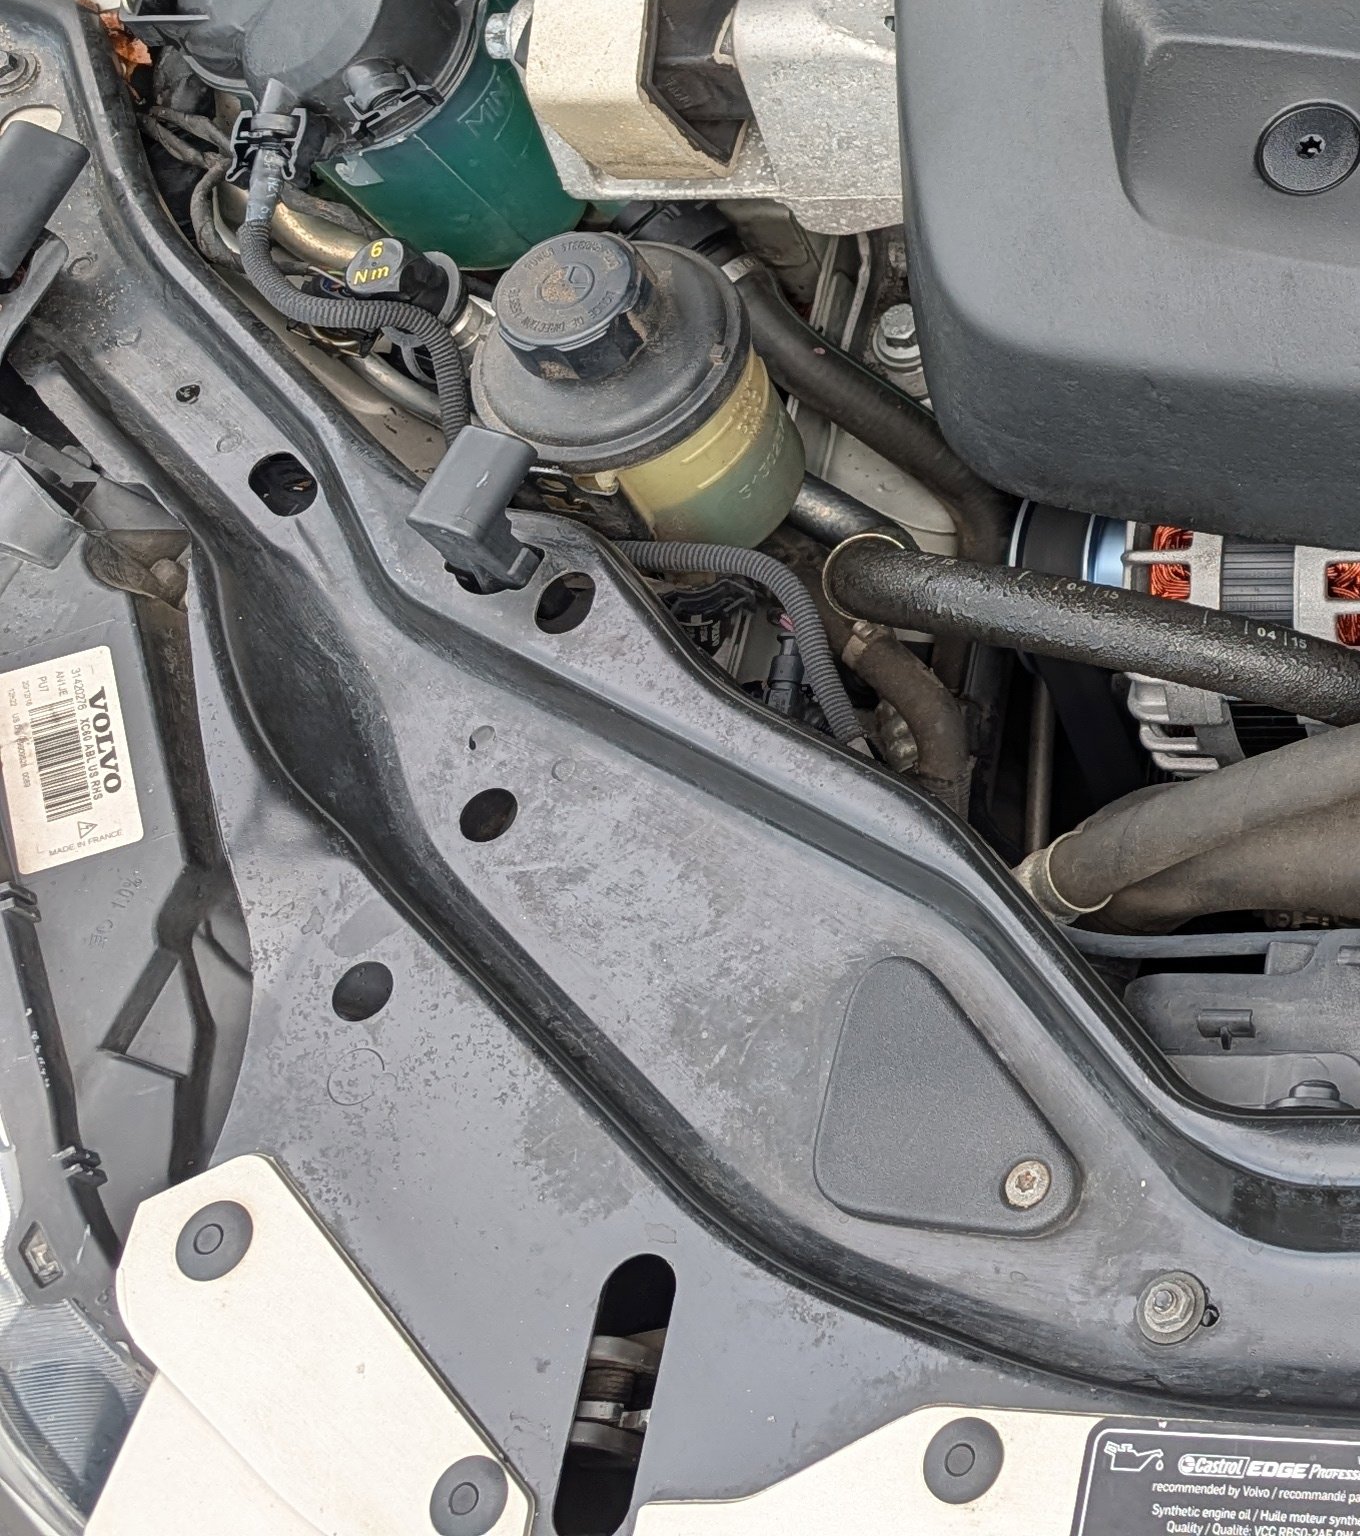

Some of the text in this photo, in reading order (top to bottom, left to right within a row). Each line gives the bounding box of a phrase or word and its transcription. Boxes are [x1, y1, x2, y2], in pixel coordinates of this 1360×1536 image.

[370, 240, 384, 258] 6
[1256, 627, 1277, 640] 04
[1290, 636, 1308, 650] 15
[71, 667, 104, 801] 31420276 XC60 ABL US RHS
[88, 686, 122, 794] VOLVO
[48, 828, 124, 856] MADE IN FRANCE
[1194, 1457, 1244, 1475] Castrol
[1246, 1460, 1310, 1479] EDGE
[1152, 1482, 1226, 1496] recommended
[1228, 1484, 1240, 1499] by
[1242, 1485, 1270, 1498] Volvo
[1278, 1490, 1346, 1502] recommandé
[1152, 1503, 1200, 1518] Synthetic
[1202, 1508, 1236, 1521] engine
[1238, 1508, 1251, 1520] oil
[1260, 1510, 1287, 1522] Huile
[1289, 1512, 1327, 1524] moteur
[1166, 1520, 1204, 1536] Quality
[1212, 1522, 1252, 1536] Qualité:
[1254, 1525, 1278, 1536] VCC
